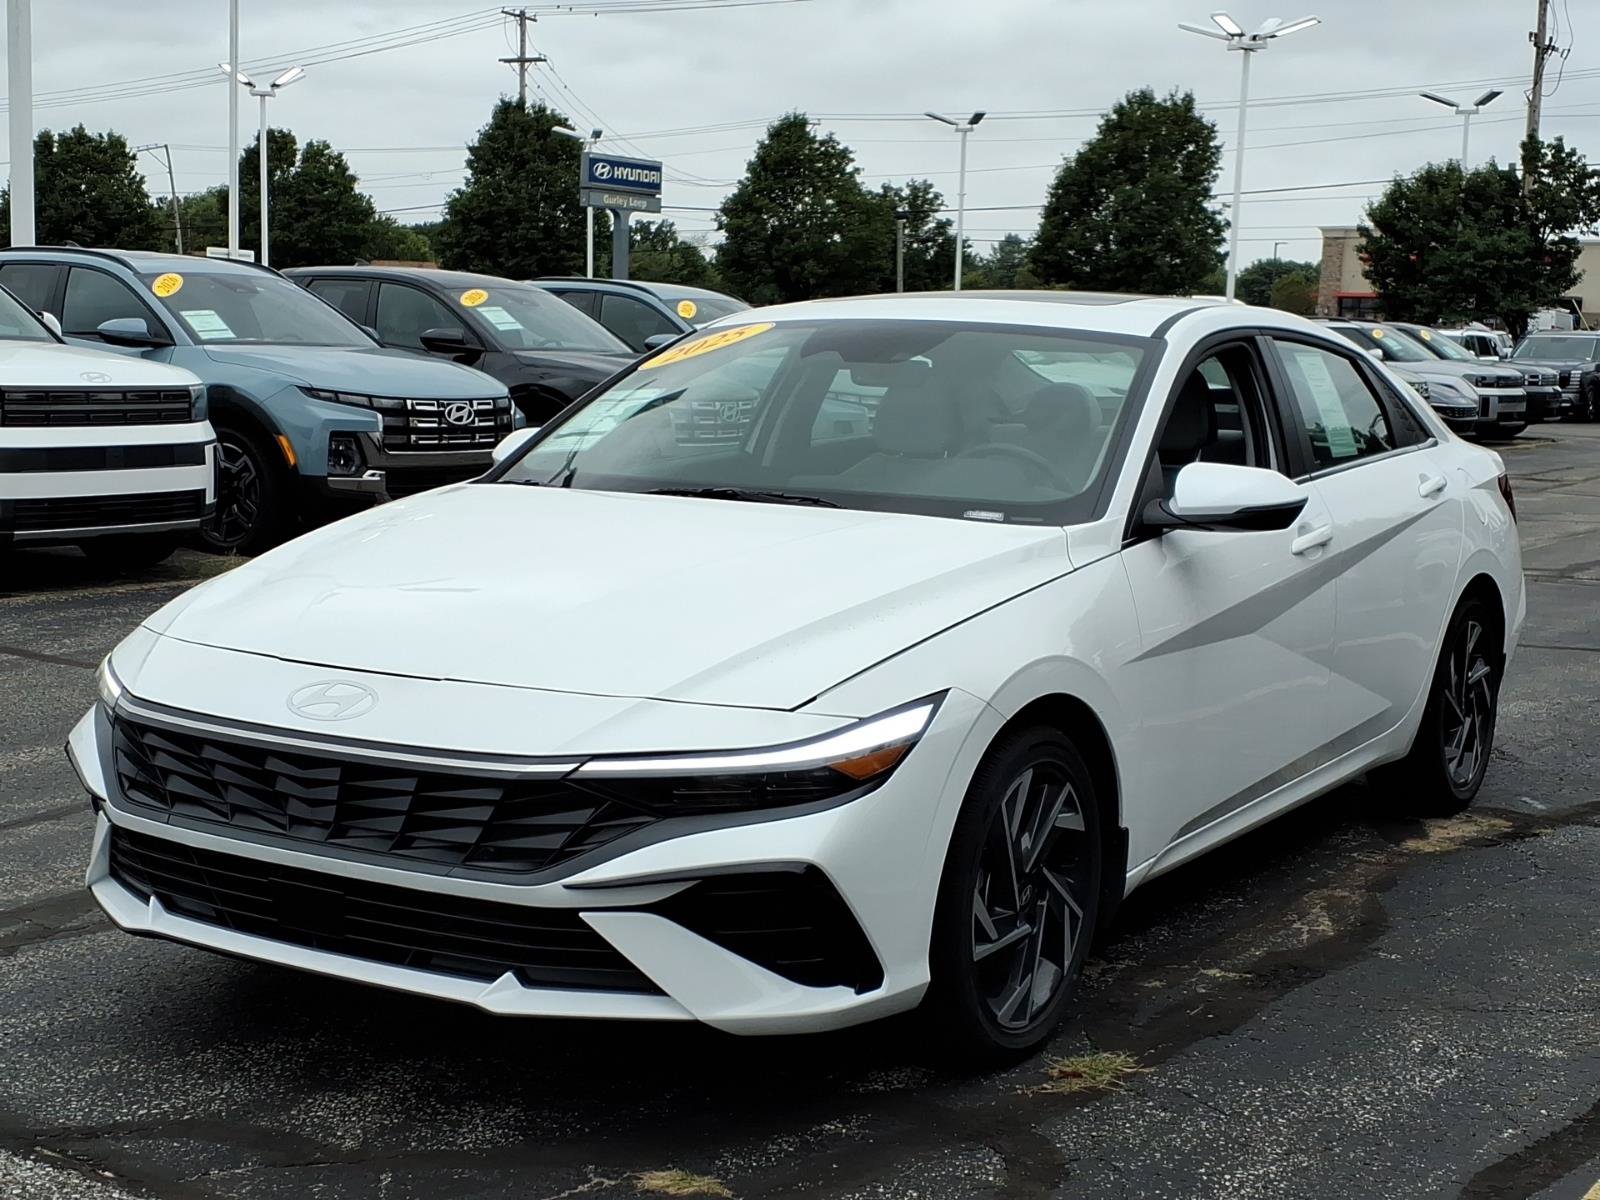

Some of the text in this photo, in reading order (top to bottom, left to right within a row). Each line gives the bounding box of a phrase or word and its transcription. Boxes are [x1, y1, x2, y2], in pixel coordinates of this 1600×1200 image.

[614, 166, 660, 184] HYUNDAI
[603, 194, 628, 208] Gurley
[659, 325, 752, 362] 2025
